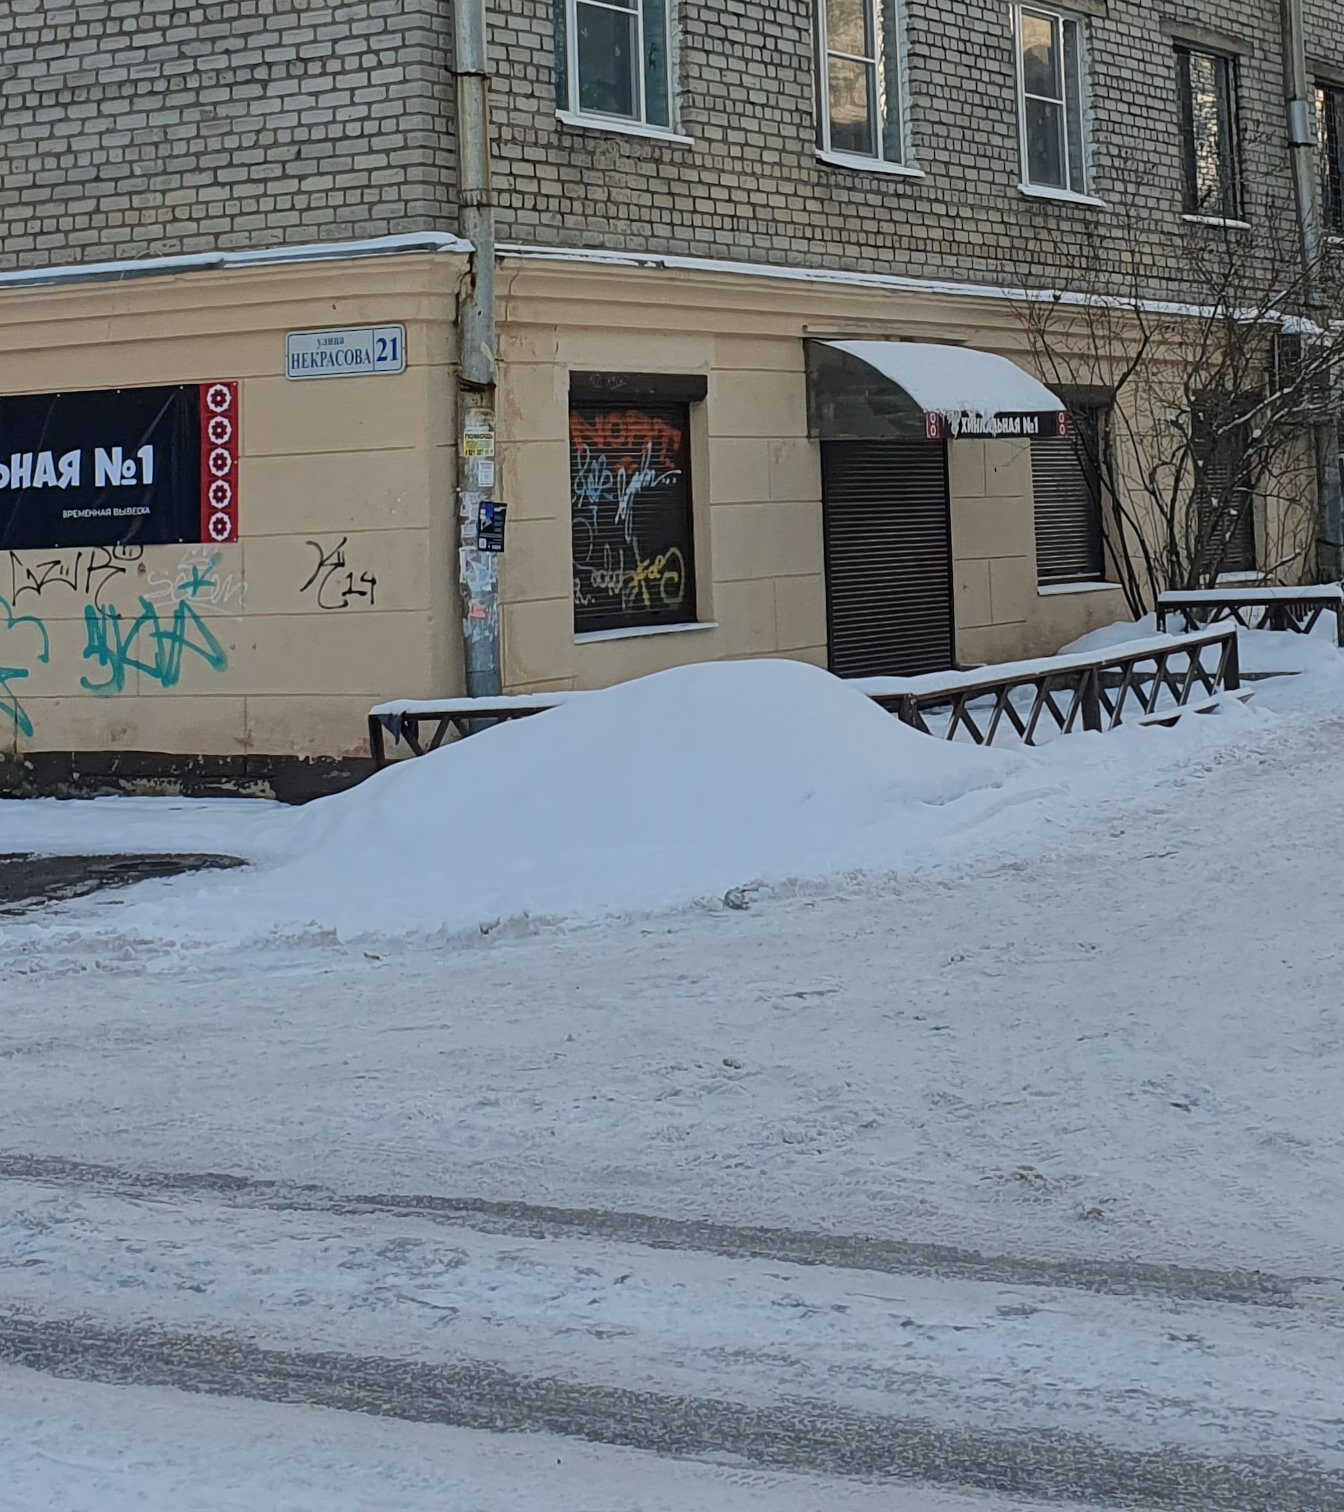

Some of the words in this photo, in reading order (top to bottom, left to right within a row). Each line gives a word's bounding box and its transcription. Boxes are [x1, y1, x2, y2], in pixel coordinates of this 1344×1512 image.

[291, 348, 372, 370] НЕКРАСОВА
[375, 336, 399, 362] 21
[1022, 416, 1039, 435] №1
[94, 444, 154, 487] №1
[62, 508, 112, 519] ВРЕМЕННАЯ
[112, 506, 151, 516] ВЫВЕСКА
